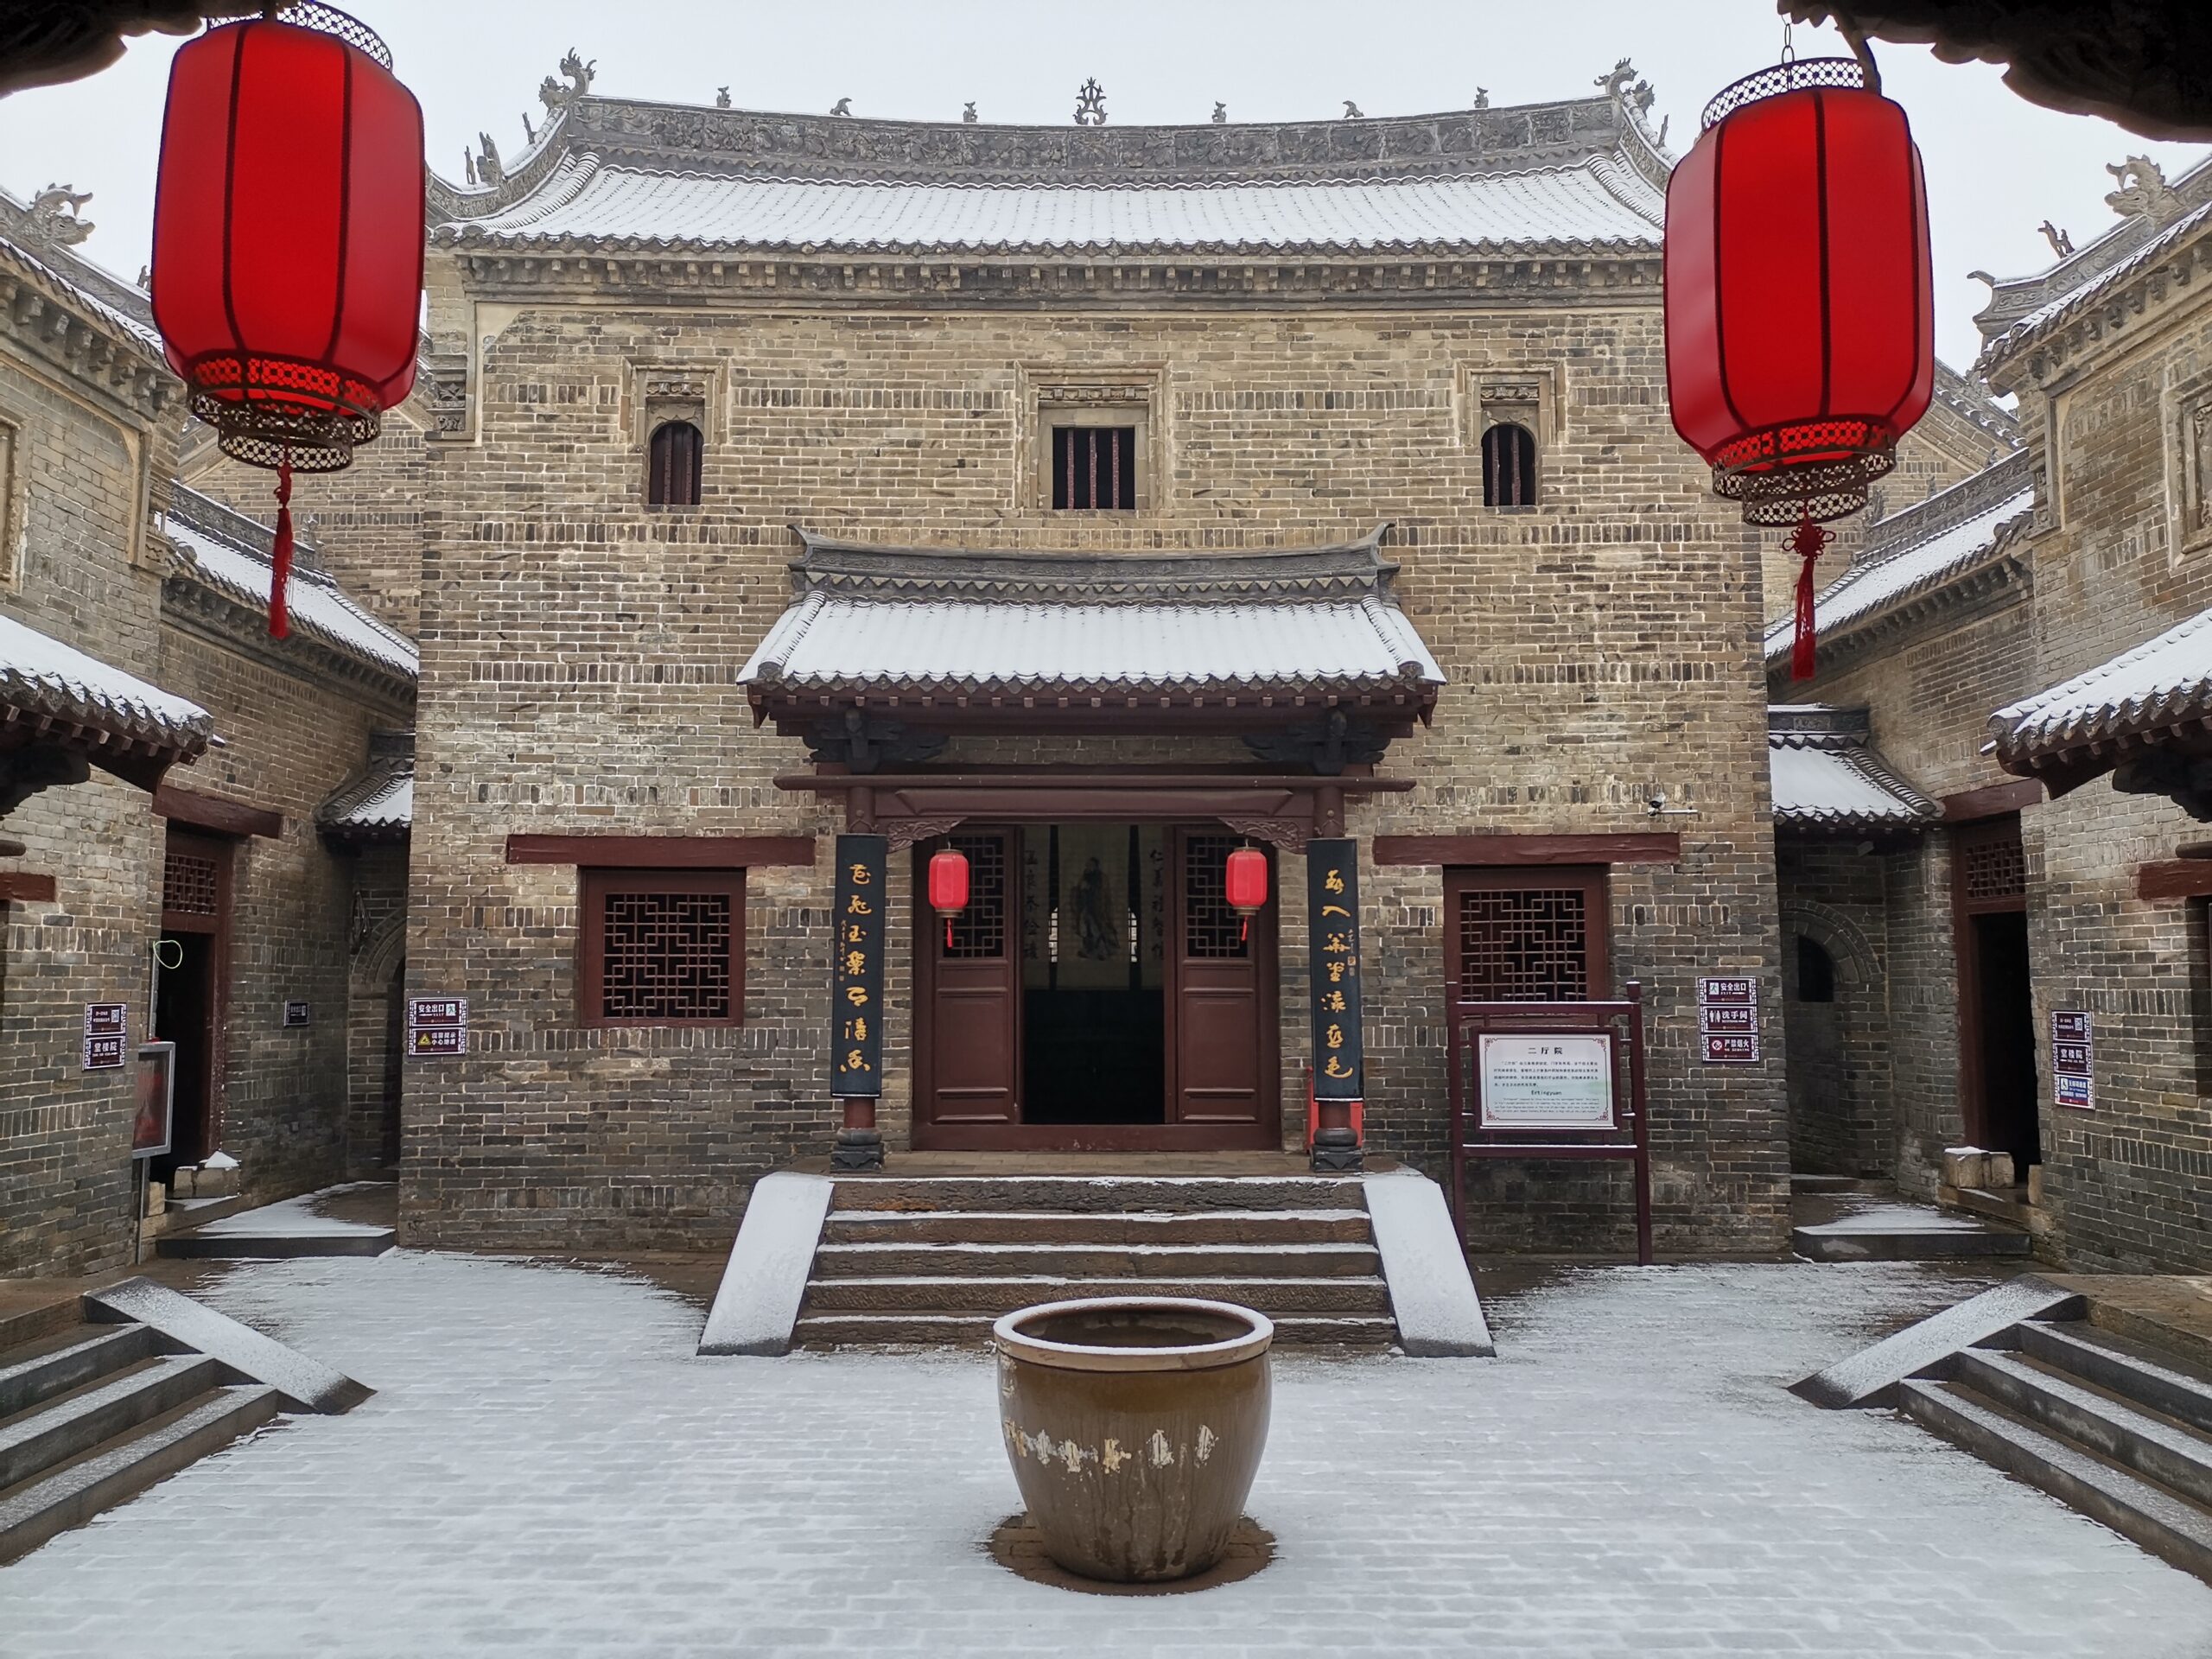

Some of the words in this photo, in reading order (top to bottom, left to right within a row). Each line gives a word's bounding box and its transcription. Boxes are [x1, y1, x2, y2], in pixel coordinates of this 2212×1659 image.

[1720, 982, 1746, 991] 安全出口
[418, 1004, 445, 1013] 安全出口
[1721, 1011, 1748, 1020] 洗手间
[1528, 1046, 1563, 1055] 二厅院
